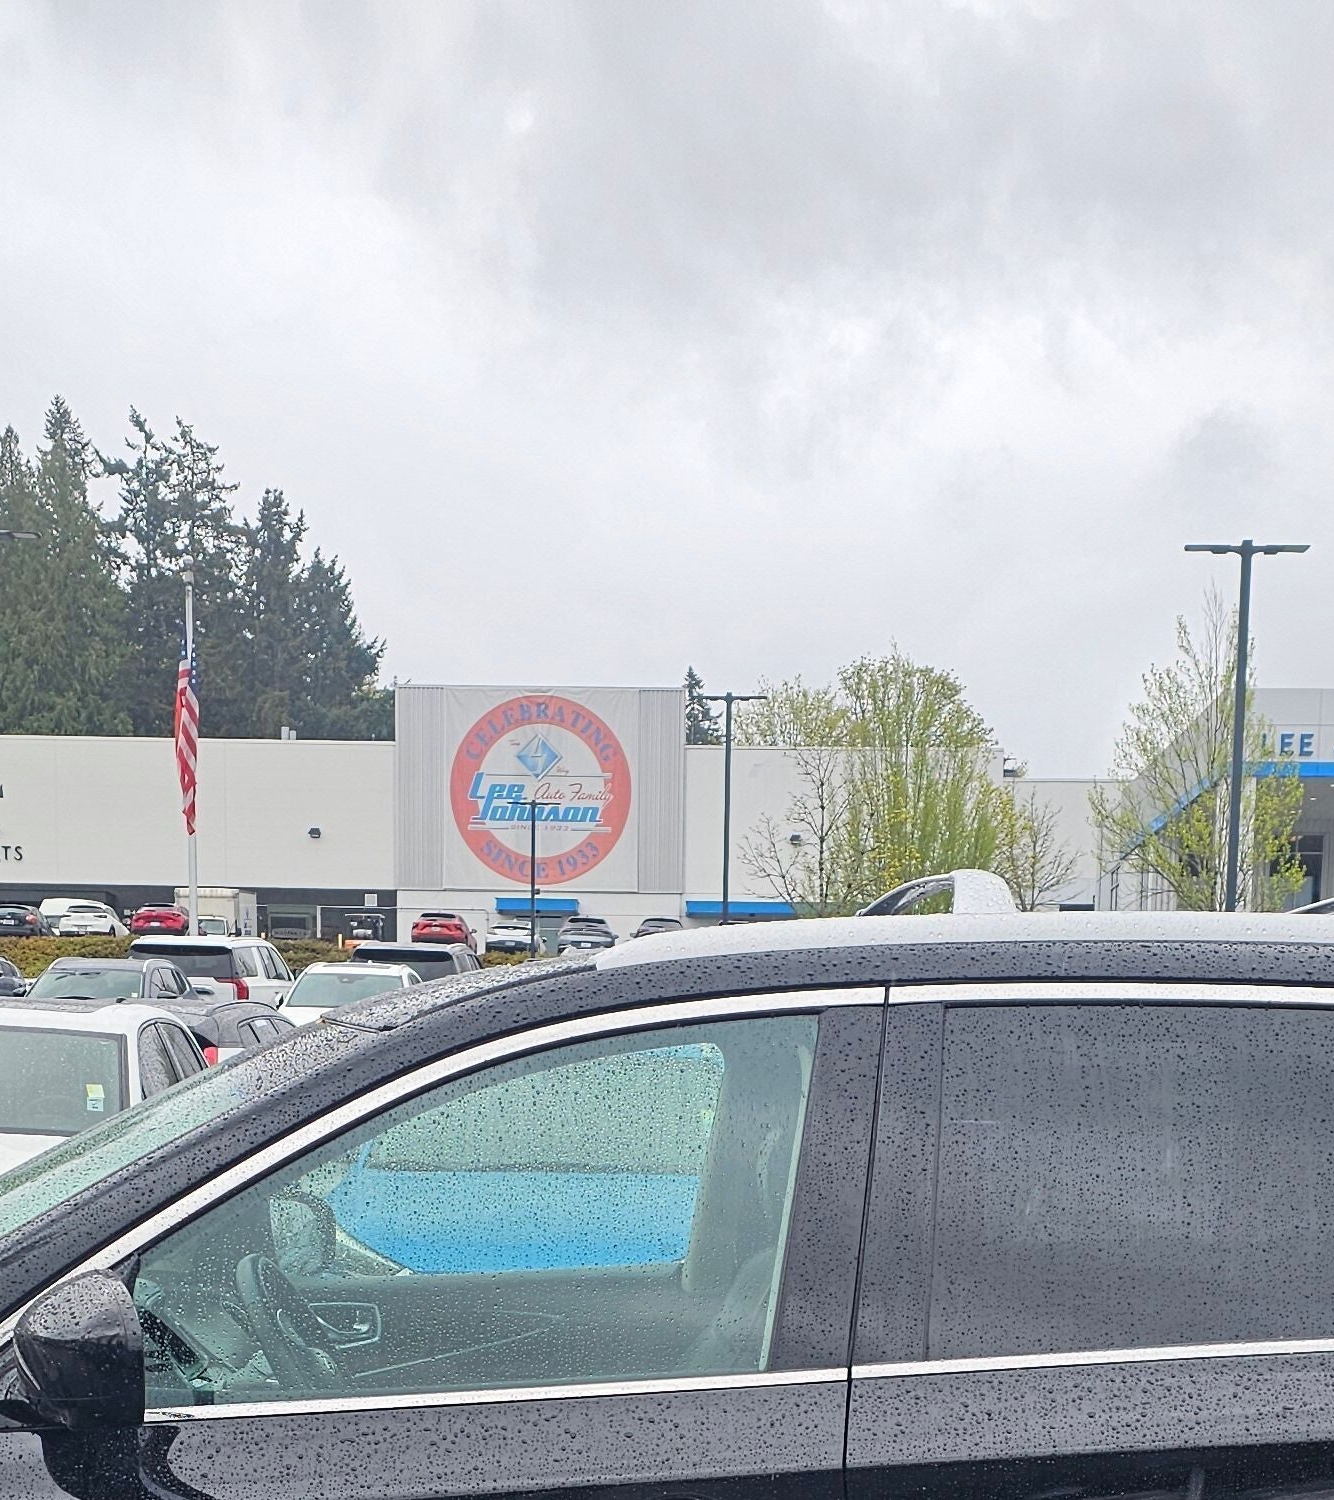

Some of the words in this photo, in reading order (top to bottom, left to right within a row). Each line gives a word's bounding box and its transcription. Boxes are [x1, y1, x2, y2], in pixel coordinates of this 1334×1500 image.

[466, 702, 615, 761] CELEBRATING
[469, 772, 528, 801] Lee
[534, 782, 565, 801] Auto
[569, 782, 613, 806] Family
[471, 796, 603, 822] Johnson
[481, 839, 549, 879] SINCE
[556, 841, 600, 876] 1933
